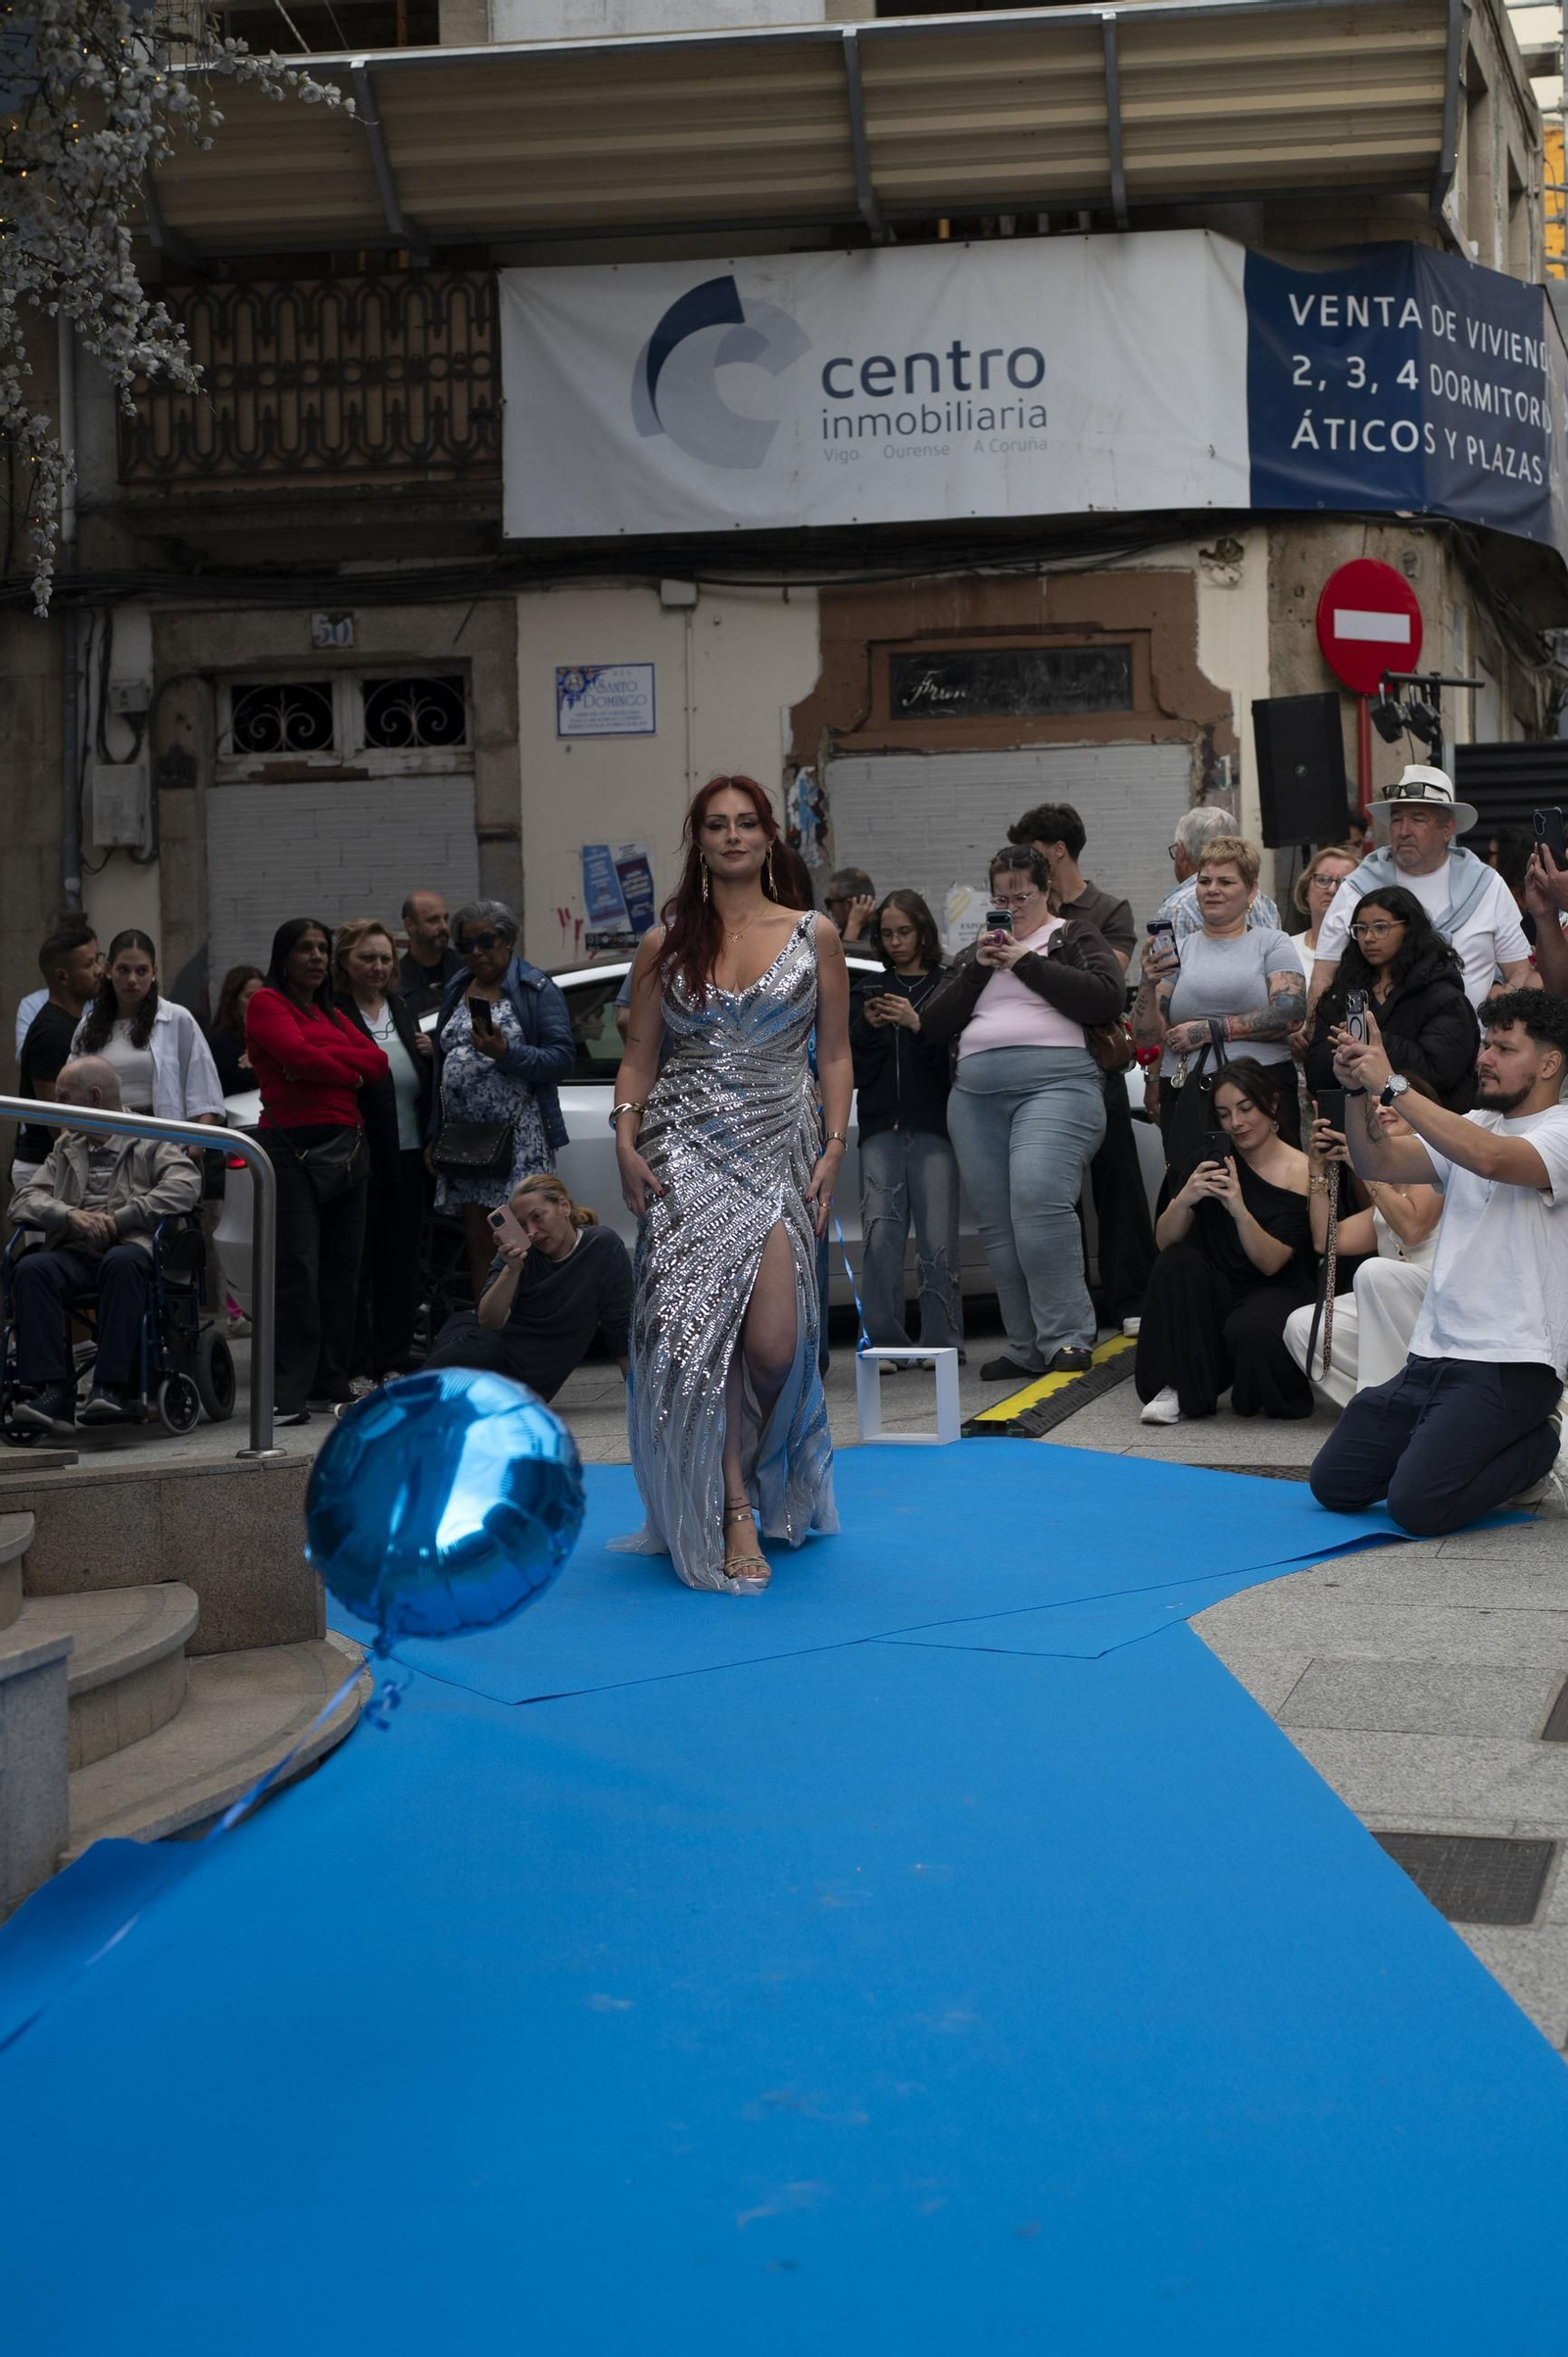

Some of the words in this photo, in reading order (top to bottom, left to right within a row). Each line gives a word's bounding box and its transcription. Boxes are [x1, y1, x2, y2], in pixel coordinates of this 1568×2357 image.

[1289, 293, 1423, 329] VENTA
[1431, 304, 1457, 342] DE
[821, 340, 1046, 399] centro
[1292, 355, 1326, 392] 2,
[1346, 356, 1379, 394] 3,
[1396, 359, 1420, 390] 4
[822, 398, 1048, 440] inmobiliaria
[823, 448, 859, 465] Vigo
[882, 444, 951, 460] Ourense
[973, 440, 985, 453] A
[989, 436, 1049, 453] Coruña
[1291, 409, 1436, 455] ÁTICOS
[1444, 427, 1457, 460] Y
[1466, 435, 1544, 485] PLAZAS
